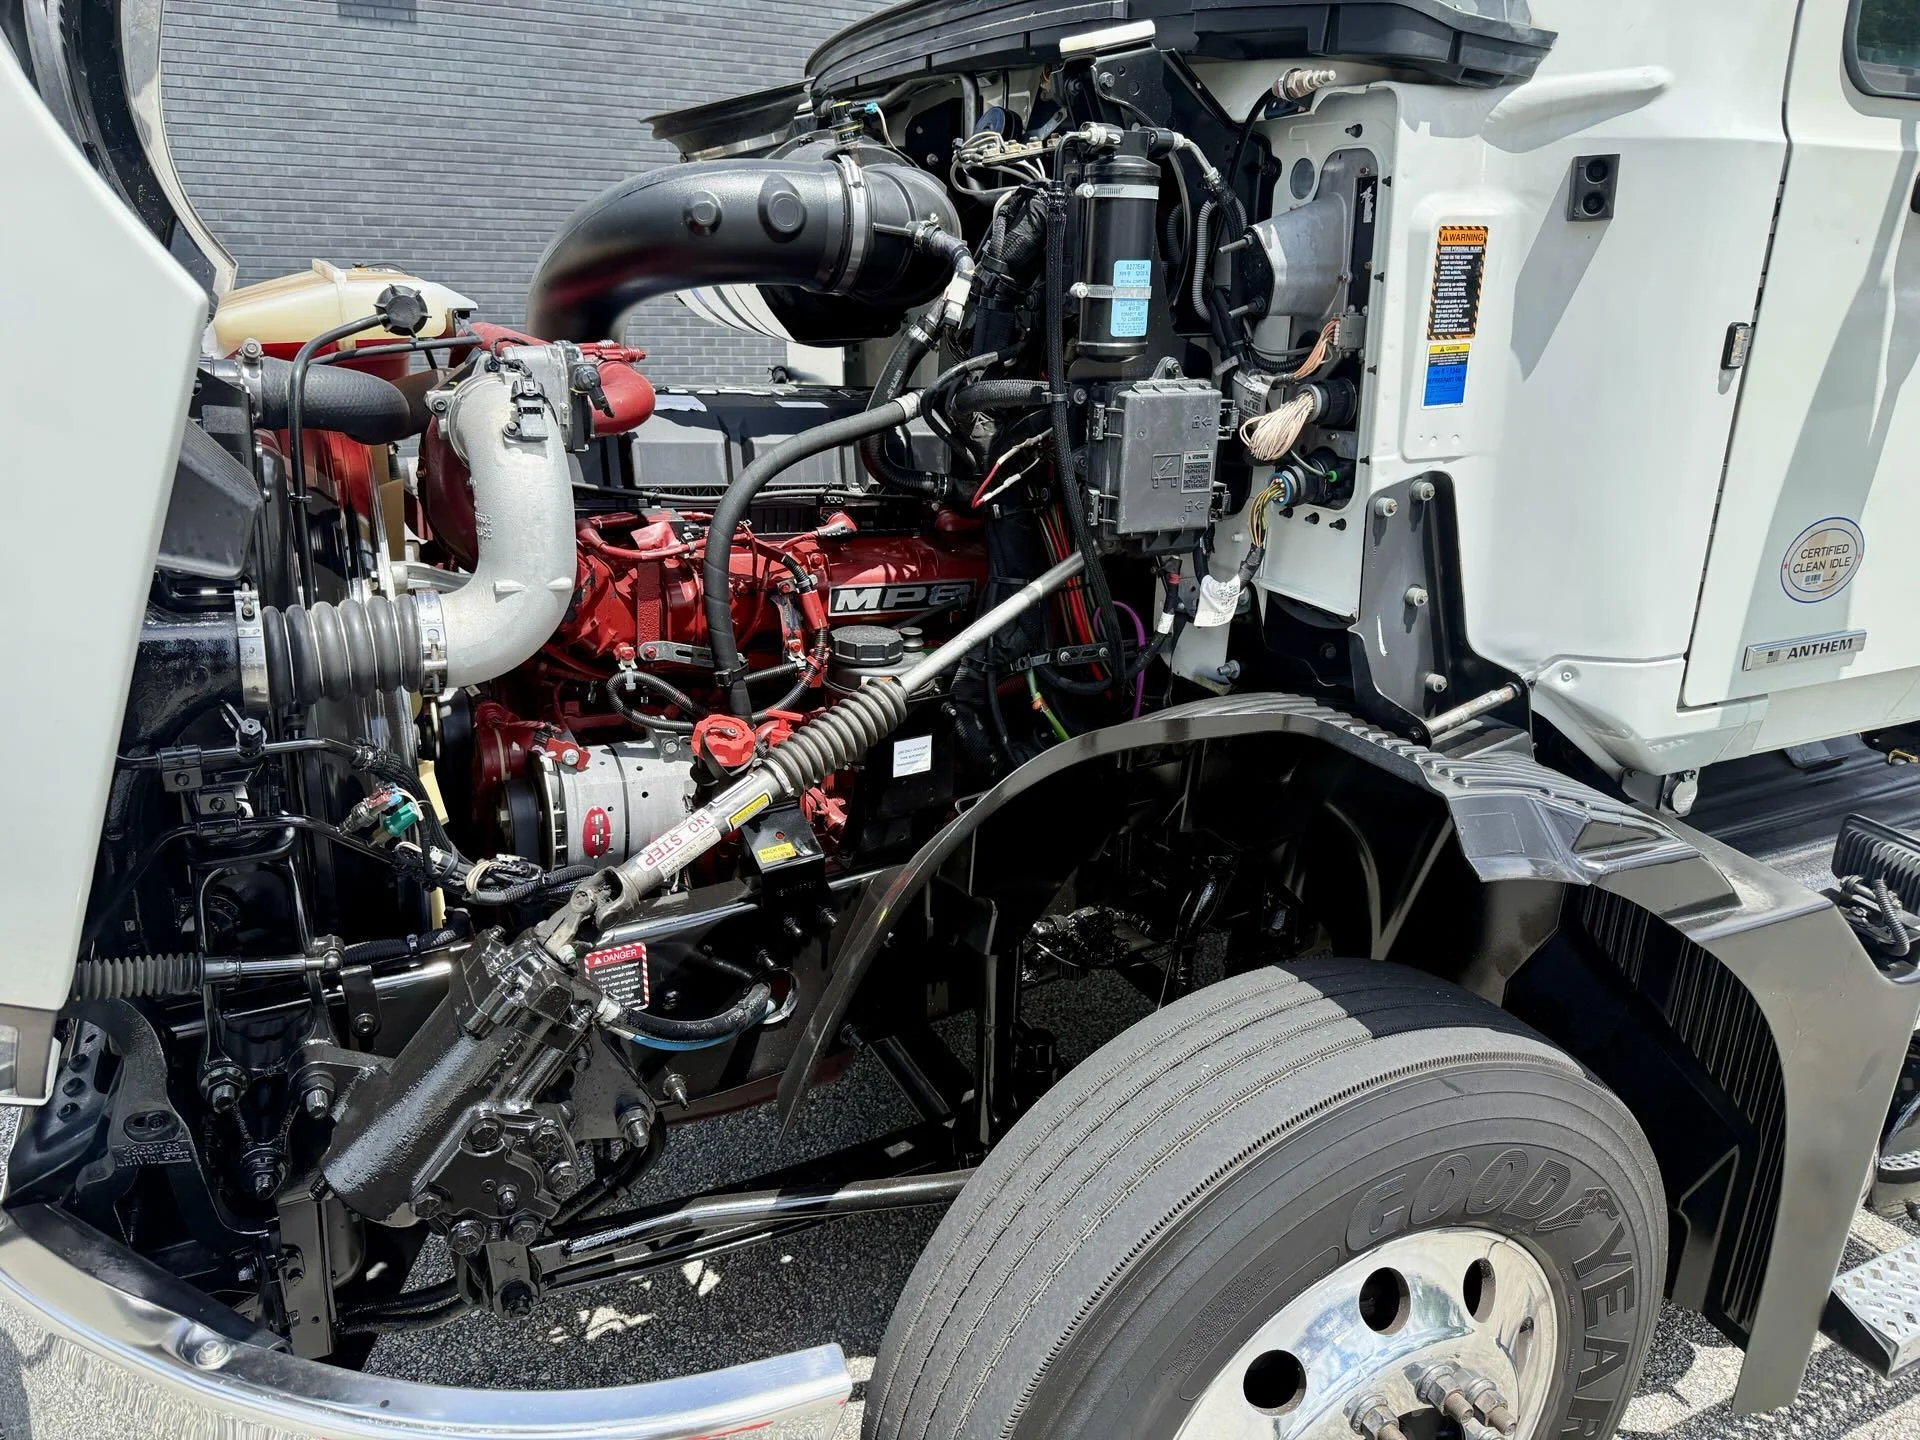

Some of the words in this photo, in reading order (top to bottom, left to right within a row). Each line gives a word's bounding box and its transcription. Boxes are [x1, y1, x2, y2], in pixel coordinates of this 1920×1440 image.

[1800, 543, 1850, 560] CERTIFIED
[1793, 559, 1825, 574] CLEAN
[1829, 556, 1852, 569] IDLE
[834, 584, 971, 612] MP8
[1787, 638, 1853, 660] ANTHEM
[688, 815, 710, 833] NO
[644, 834, 683, 866] STEP
[603, 949, 637, 963] DANGER
